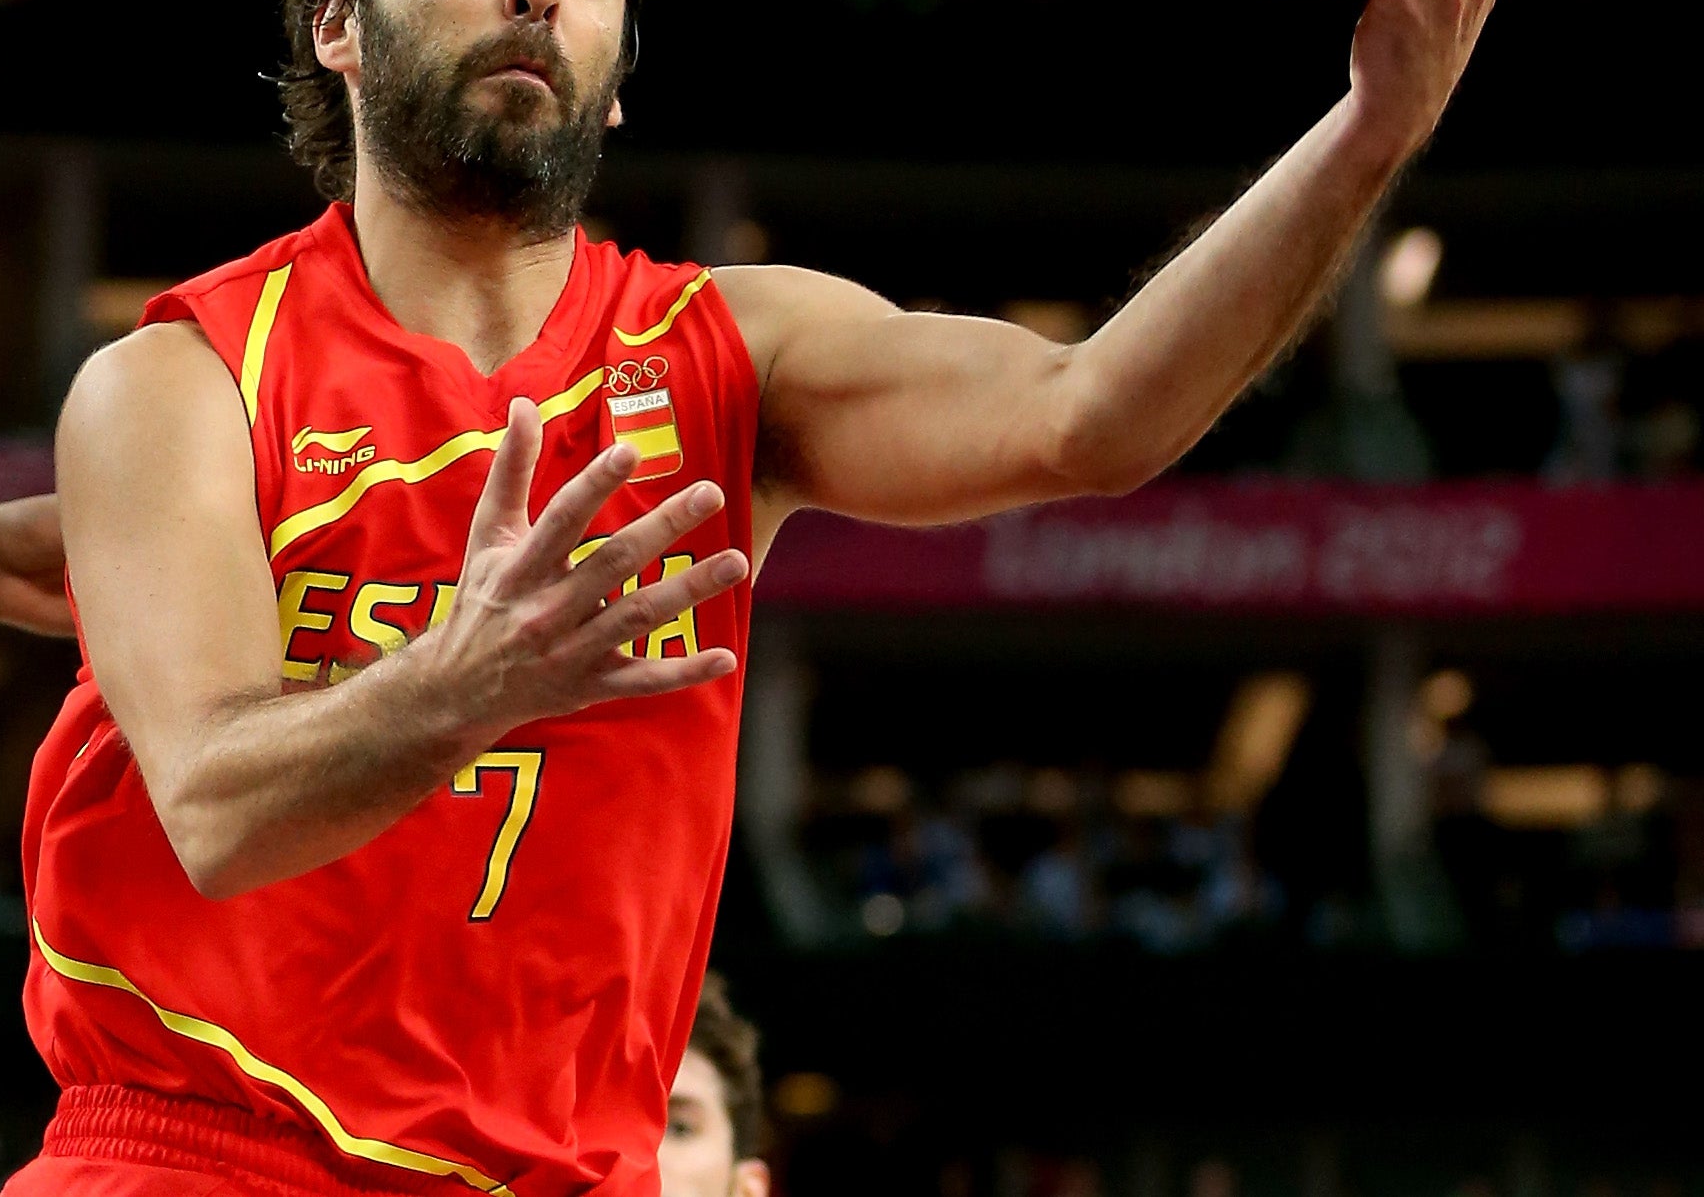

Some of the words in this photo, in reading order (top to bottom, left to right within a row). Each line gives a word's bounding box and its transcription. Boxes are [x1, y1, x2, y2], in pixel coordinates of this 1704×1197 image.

[614, 393, 665, 413] ESPAÑA
[293, 444, 376, 475] LI-NING
[453, 745, 546, 923] 7
